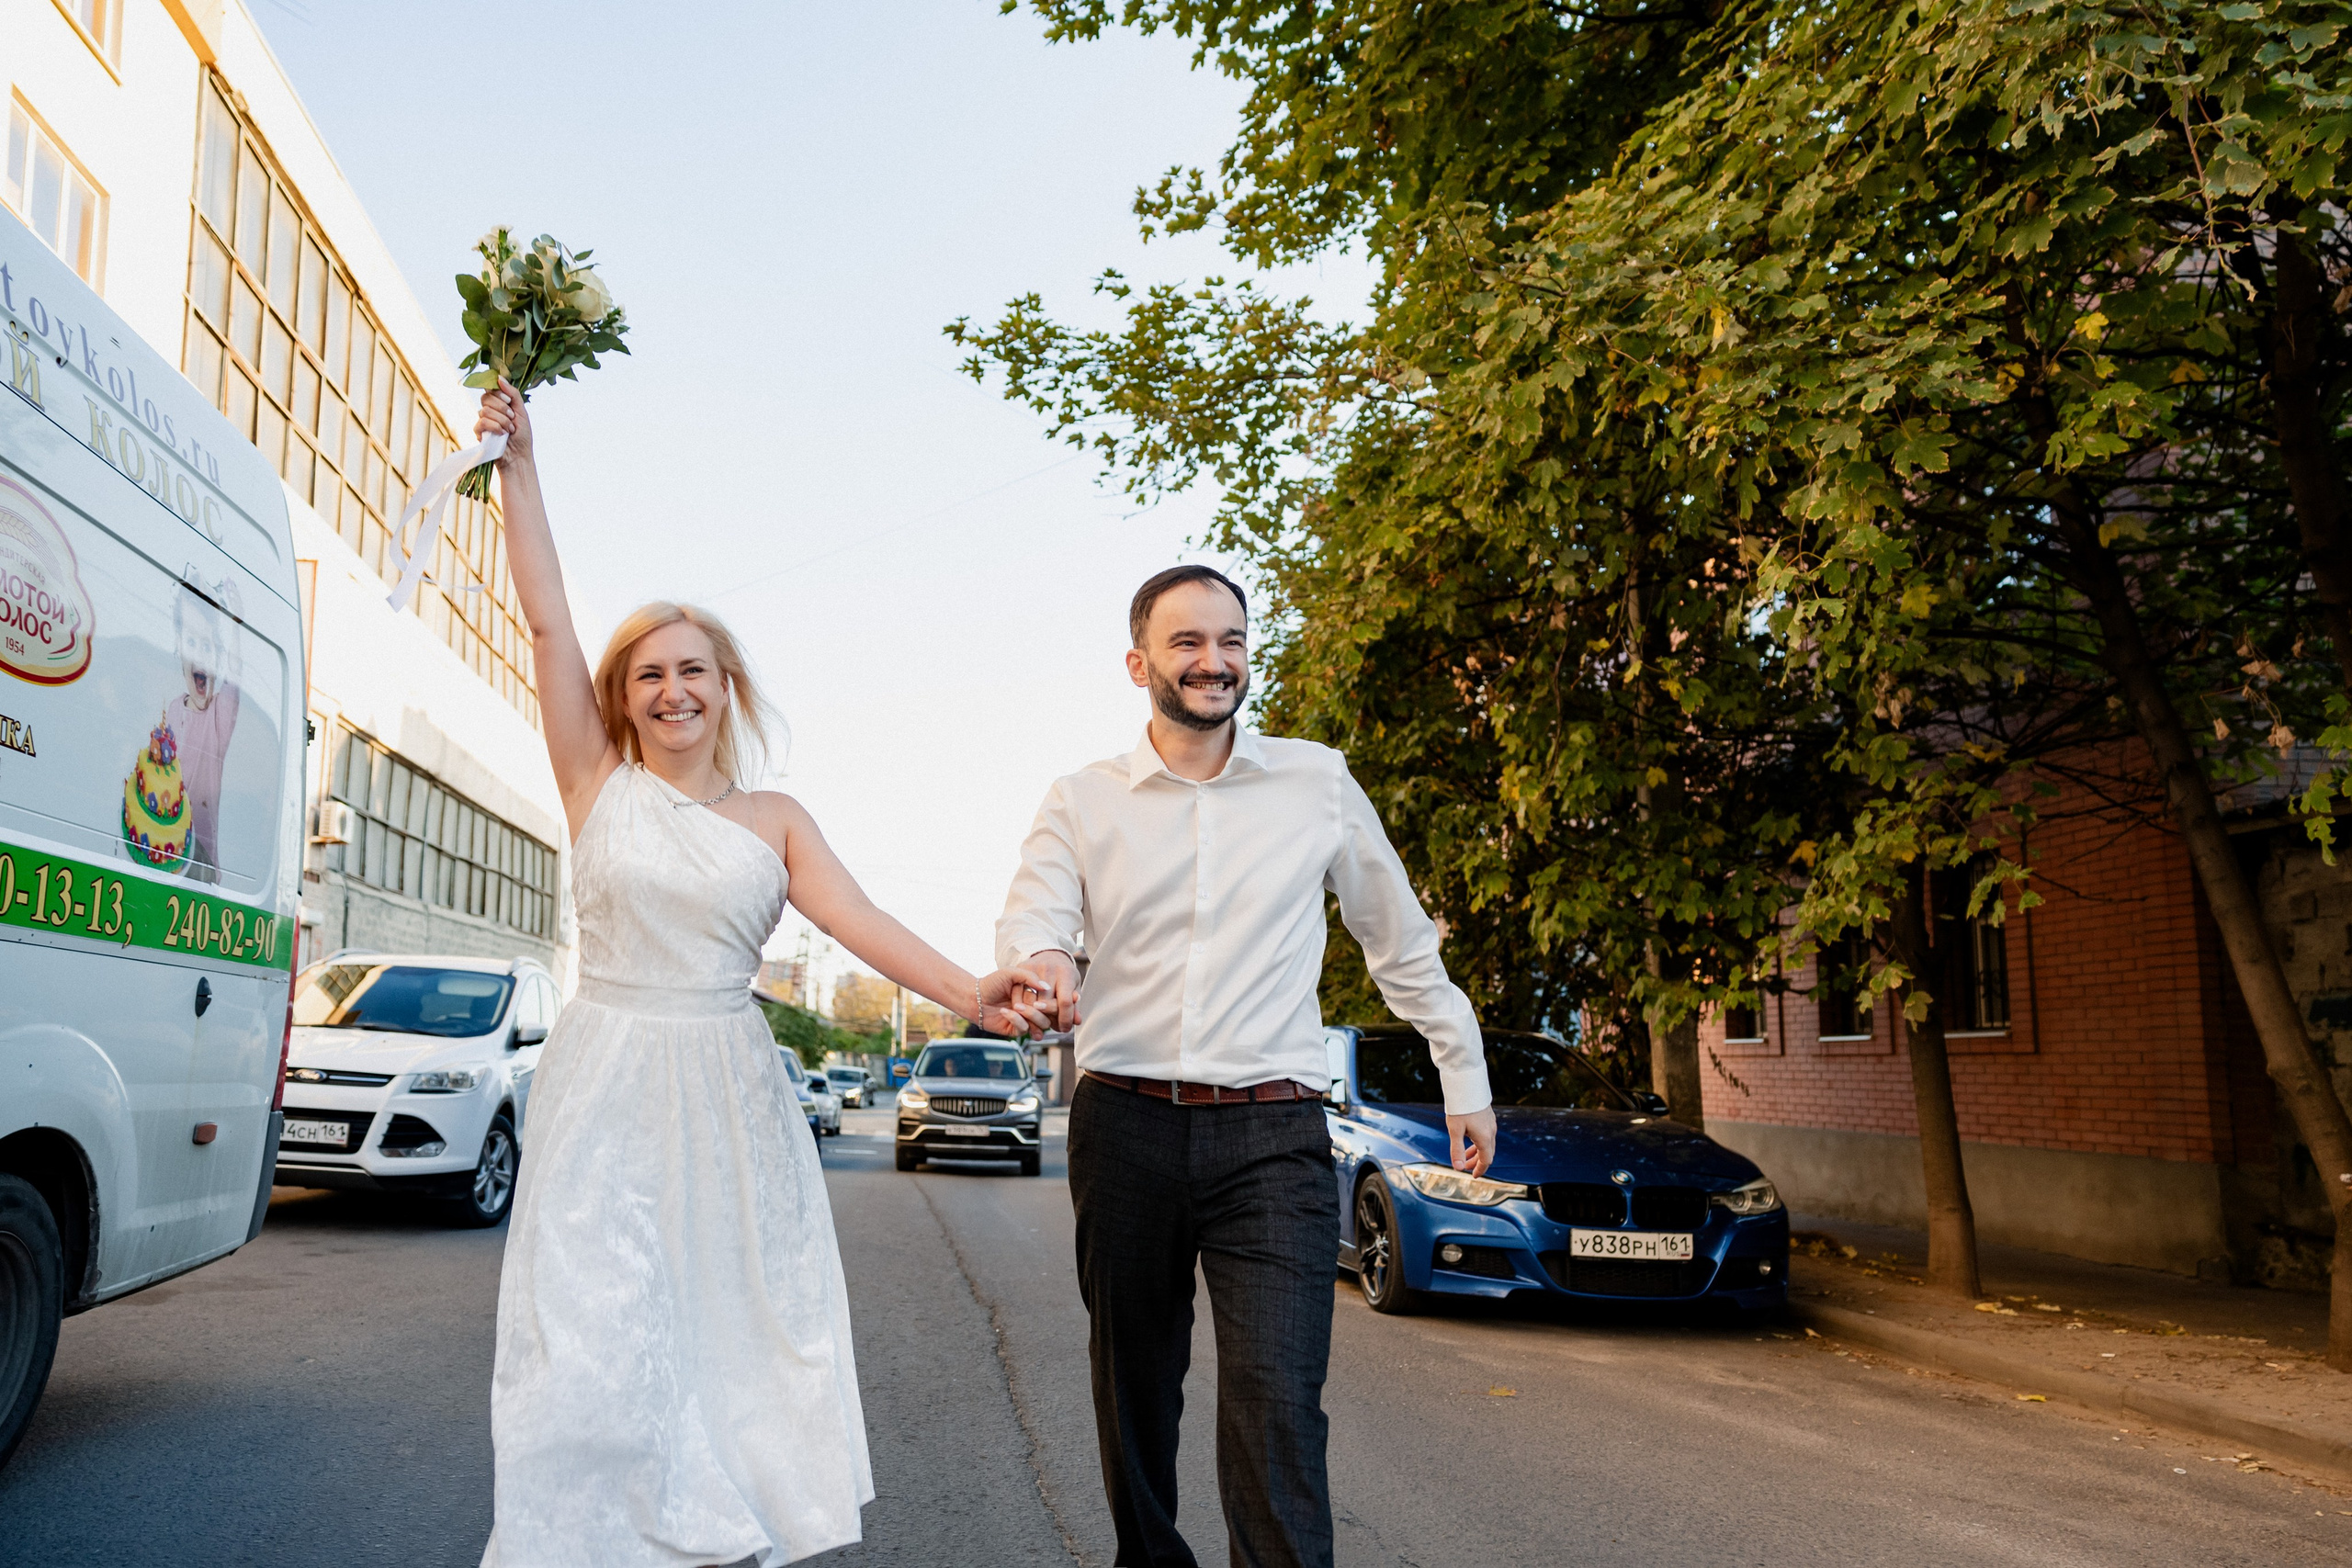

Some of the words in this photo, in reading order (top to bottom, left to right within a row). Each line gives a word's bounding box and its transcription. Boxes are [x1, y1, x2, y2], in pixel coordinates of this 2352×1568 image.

[0, 320, 45, 412] Й
[84, 394, 222, 546] КОЛОС
[6, 636, 25, 656] 1954
[0, 714, 36, 758] КА
[164, 895, 275, 963] 240-82-90
[1579, 1234, 1657, 1256] У838РН
[1661, 1235, 1688, 1252] 161
